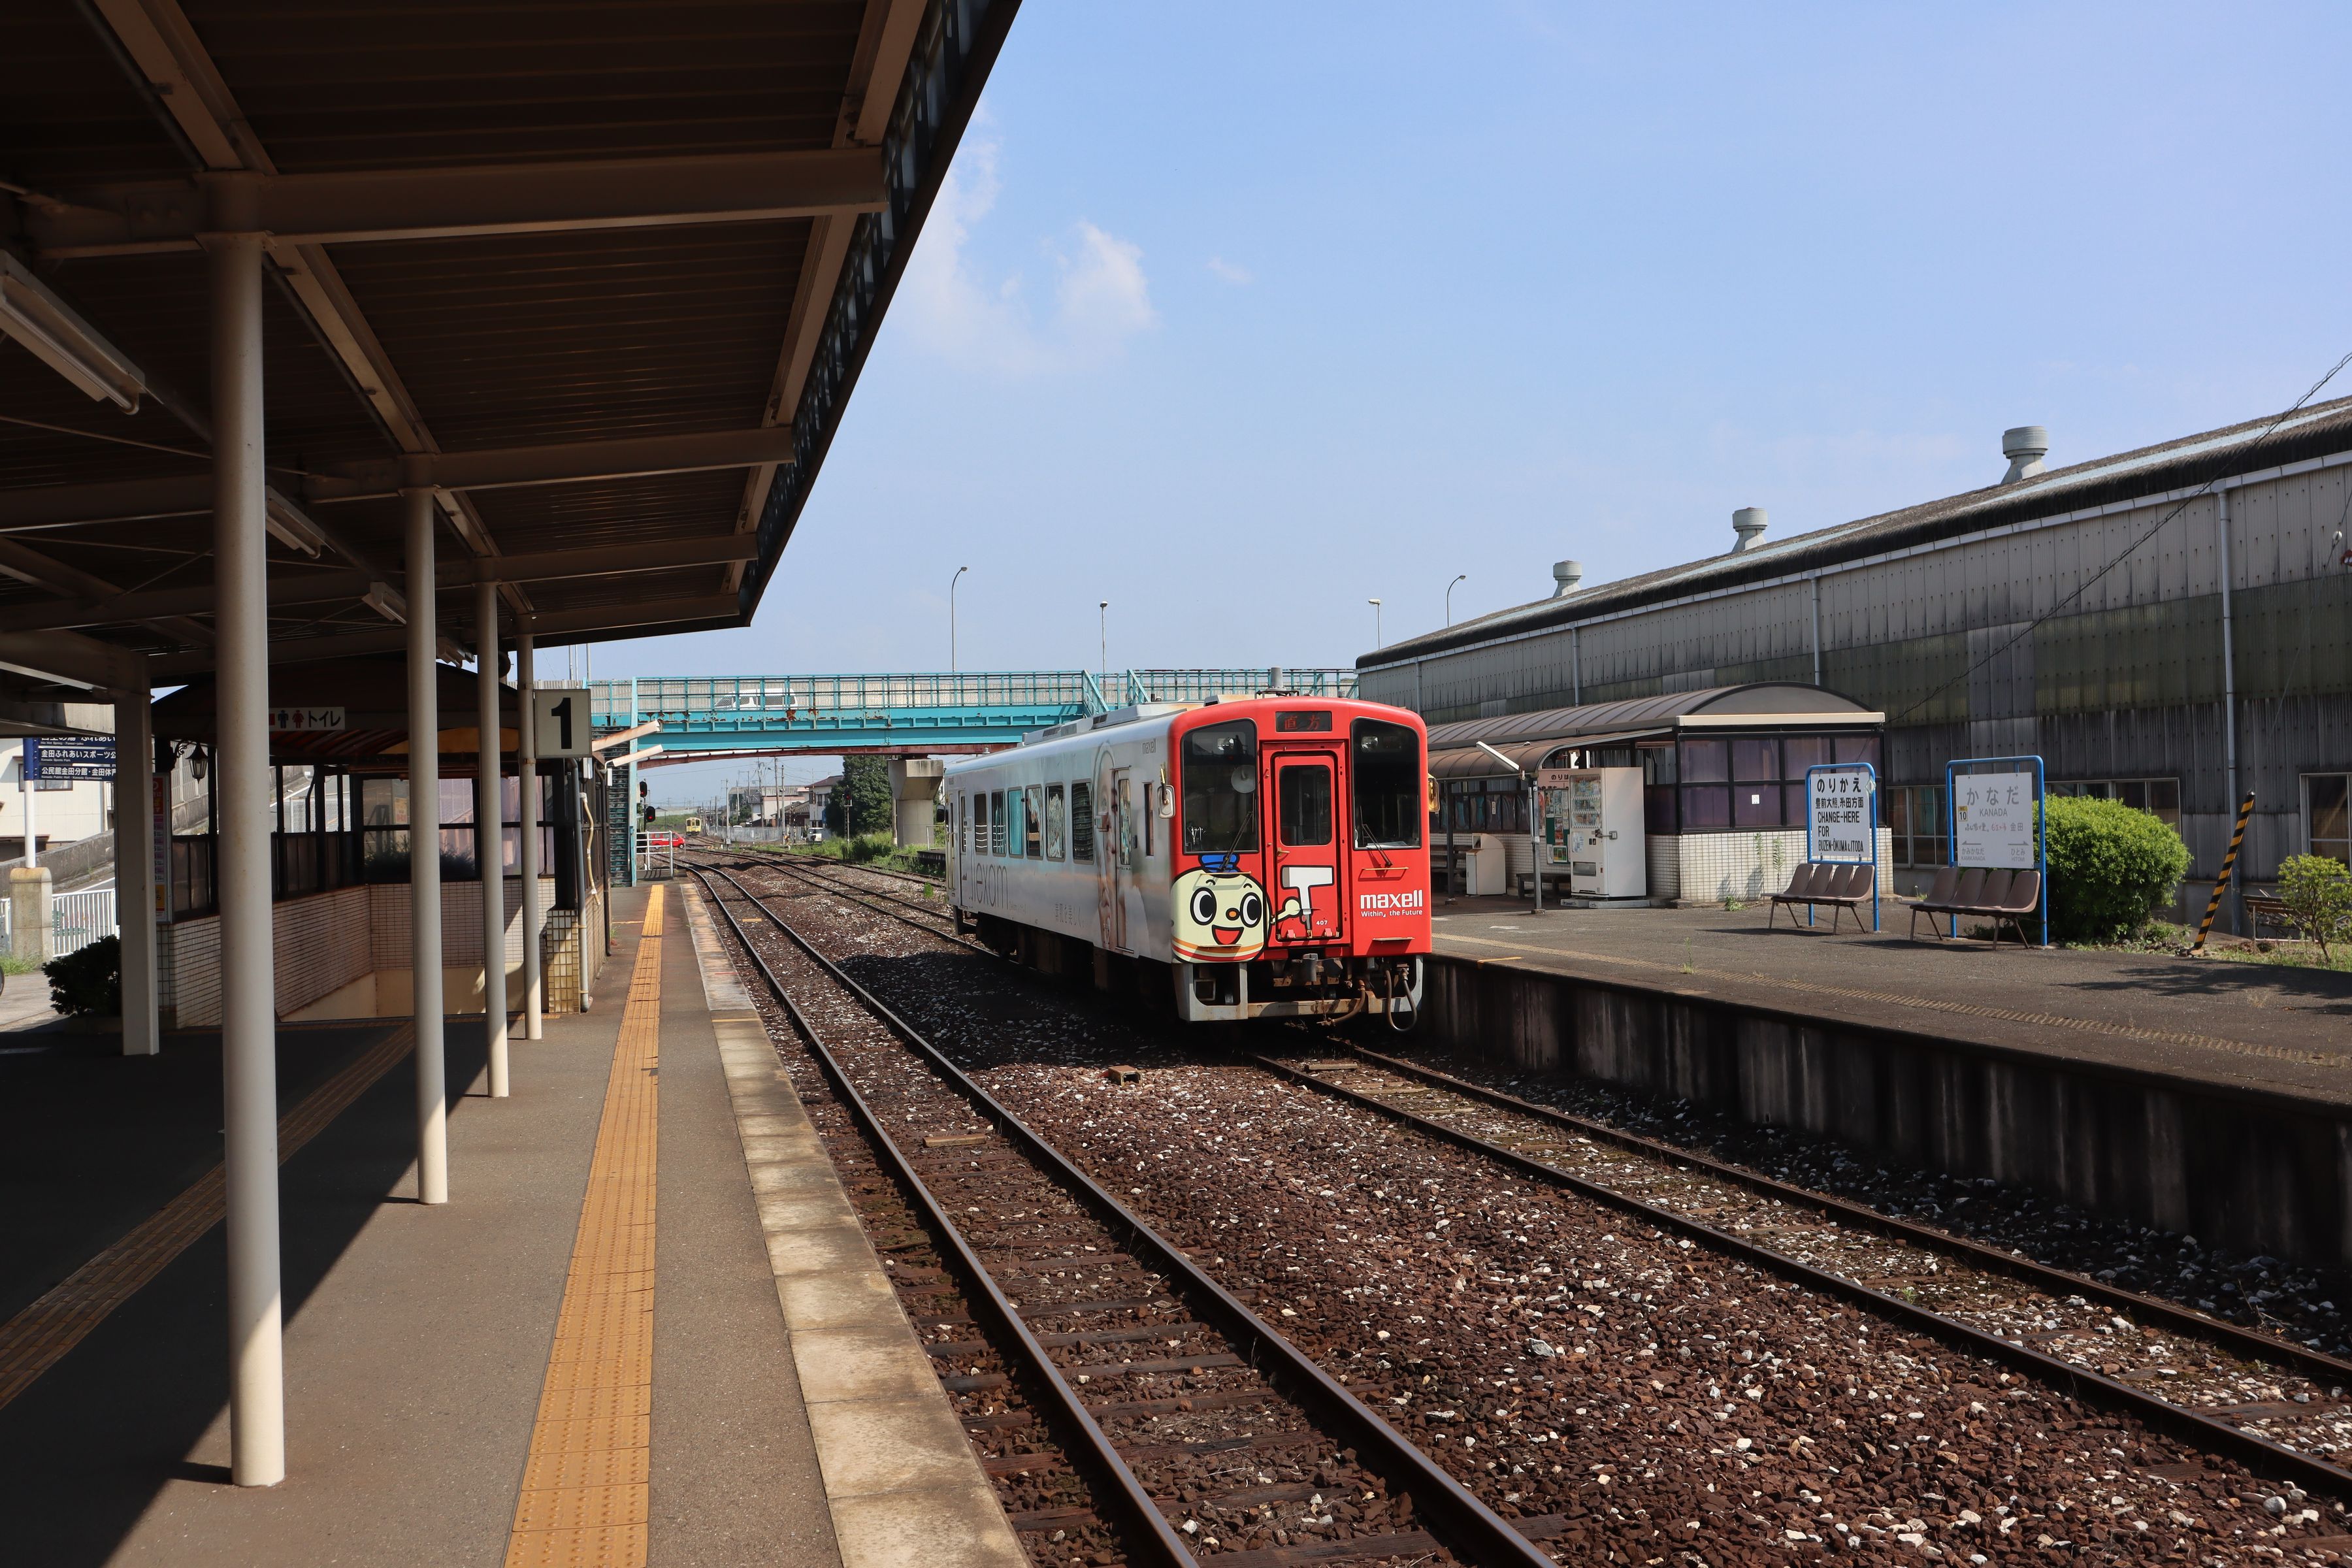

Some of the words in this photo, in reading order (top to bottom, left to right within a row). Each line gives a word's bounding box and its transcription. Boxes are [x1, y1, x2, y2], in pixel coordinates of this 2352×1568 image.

[308, 710, 341, 728] トイレ
[551, 697, 572, 749] 1
[1284, 714, 1320, 731] 直方
[1817, 777, 1861, 793] のりかえ
[1966, 785, 2019, 806] かなだ
[1818, 811, 1860, 823] CHANGE-HERE
[1959, 811, 1967, 821] 10
[1979, 808, 2008, 817] KANADA
[1818, 826, 1829, 837] FOR
[2010, 822, 2023, 832] 金田
[1360, 889, 1423, 909] maxell
